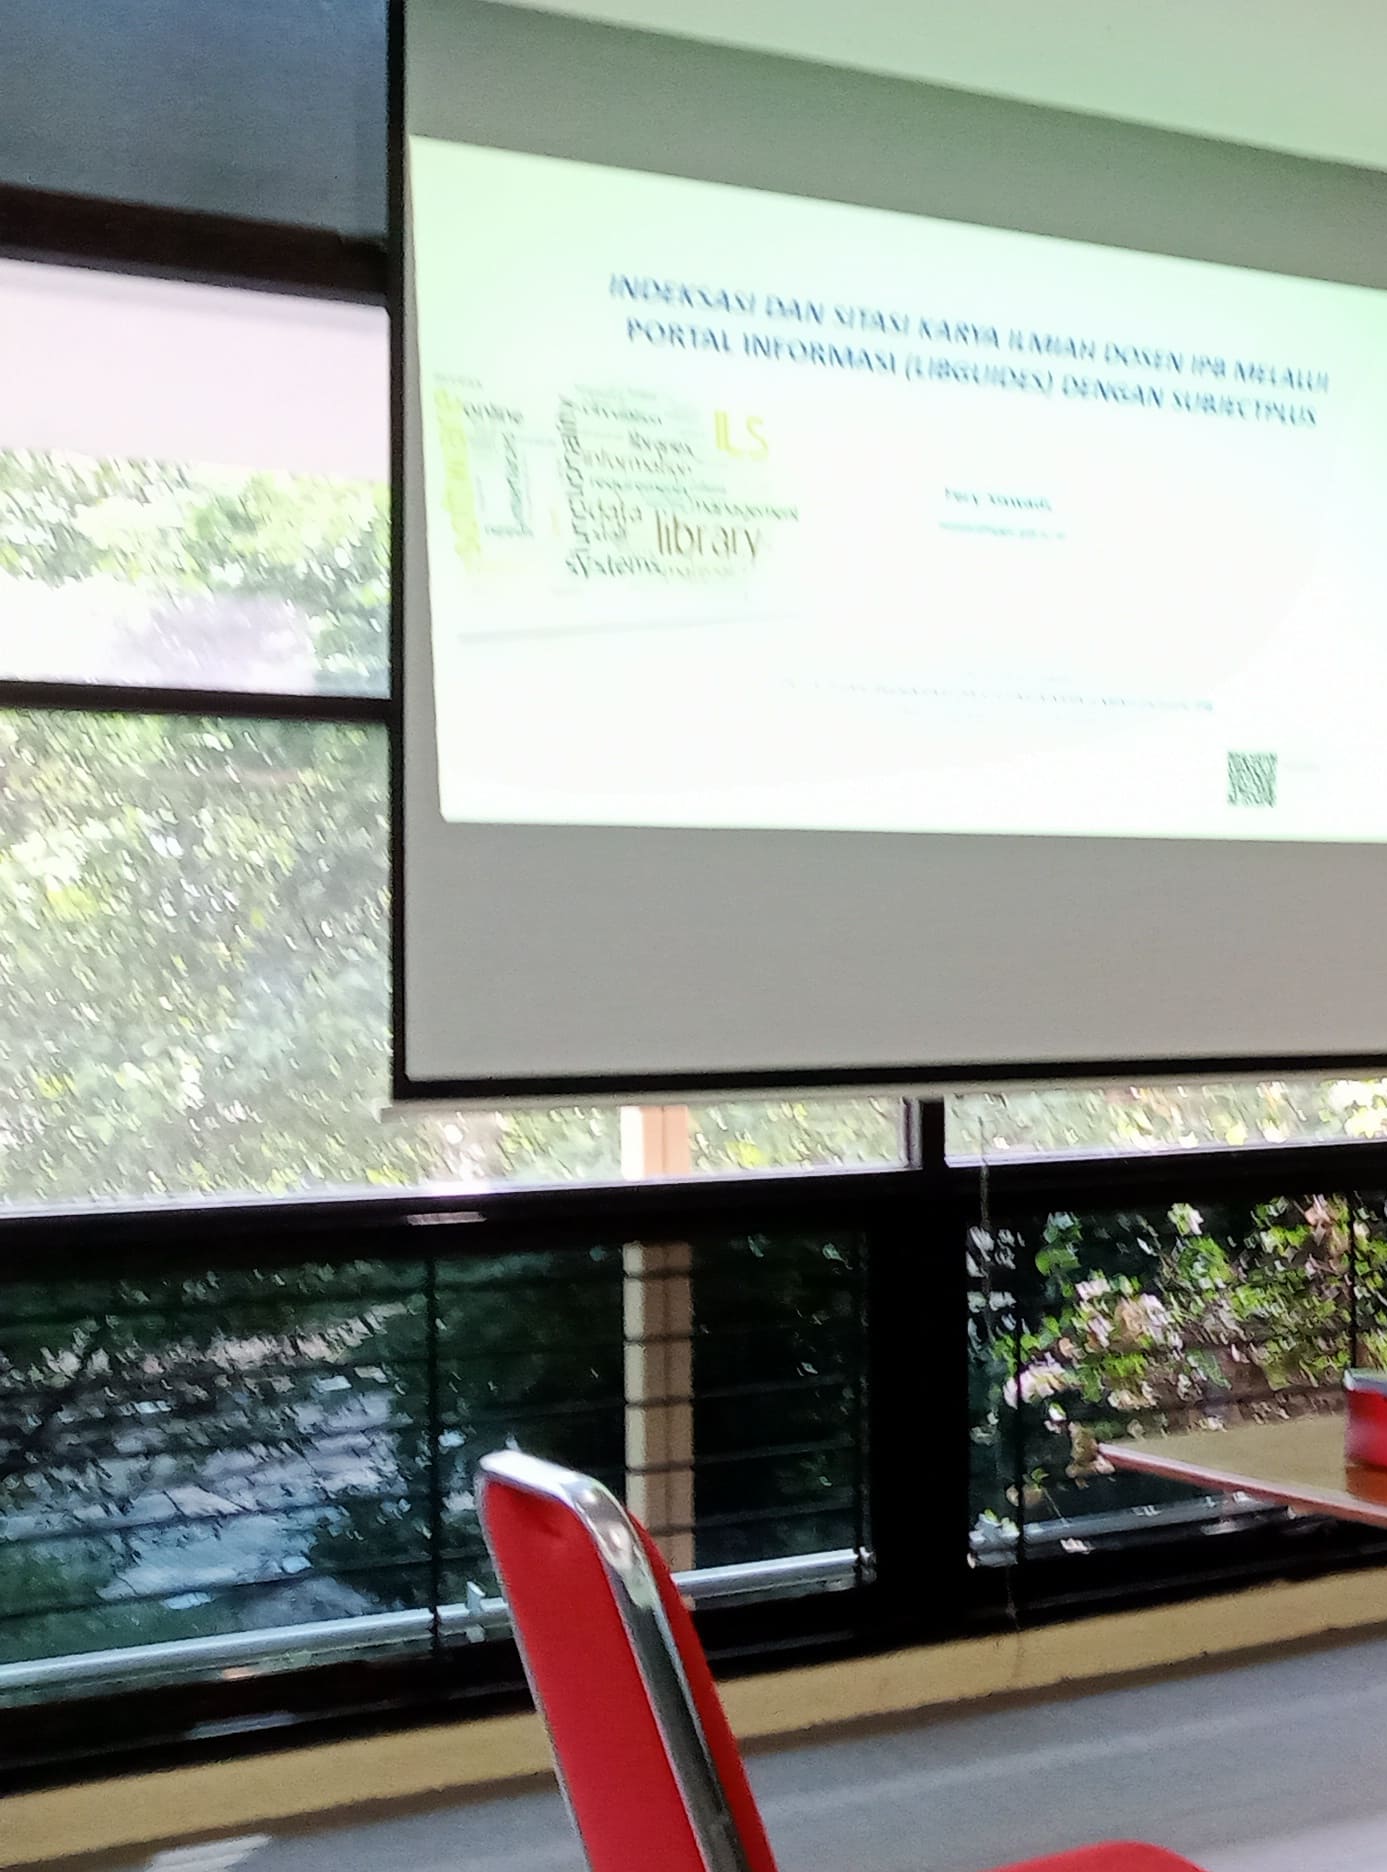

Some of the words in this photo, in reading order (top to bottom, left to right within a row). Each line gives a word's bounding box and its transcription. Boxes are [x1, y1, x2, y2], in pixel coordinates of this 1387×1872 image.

[608, 271, 757, 317] INDEKSASI
[765, 293, 825, 326] DAN
[833, 301, 911, 338] SITASI
[918, 315, 1001, 349] KARYA
[1008, 327, 1097, 361] ILMIAH
[1104, 340, 1184, 374] DOSEN
[1191, 352, 1228, 380] IPB
[1233, 358, 1331, 394] MELALUI
[626, 315, 732, 353] PORTAL
[742, 330, 898, 376] INFORMASI
[1061, 371, 1165, 410] DENGAN
[655, 507, 763, 568] library
